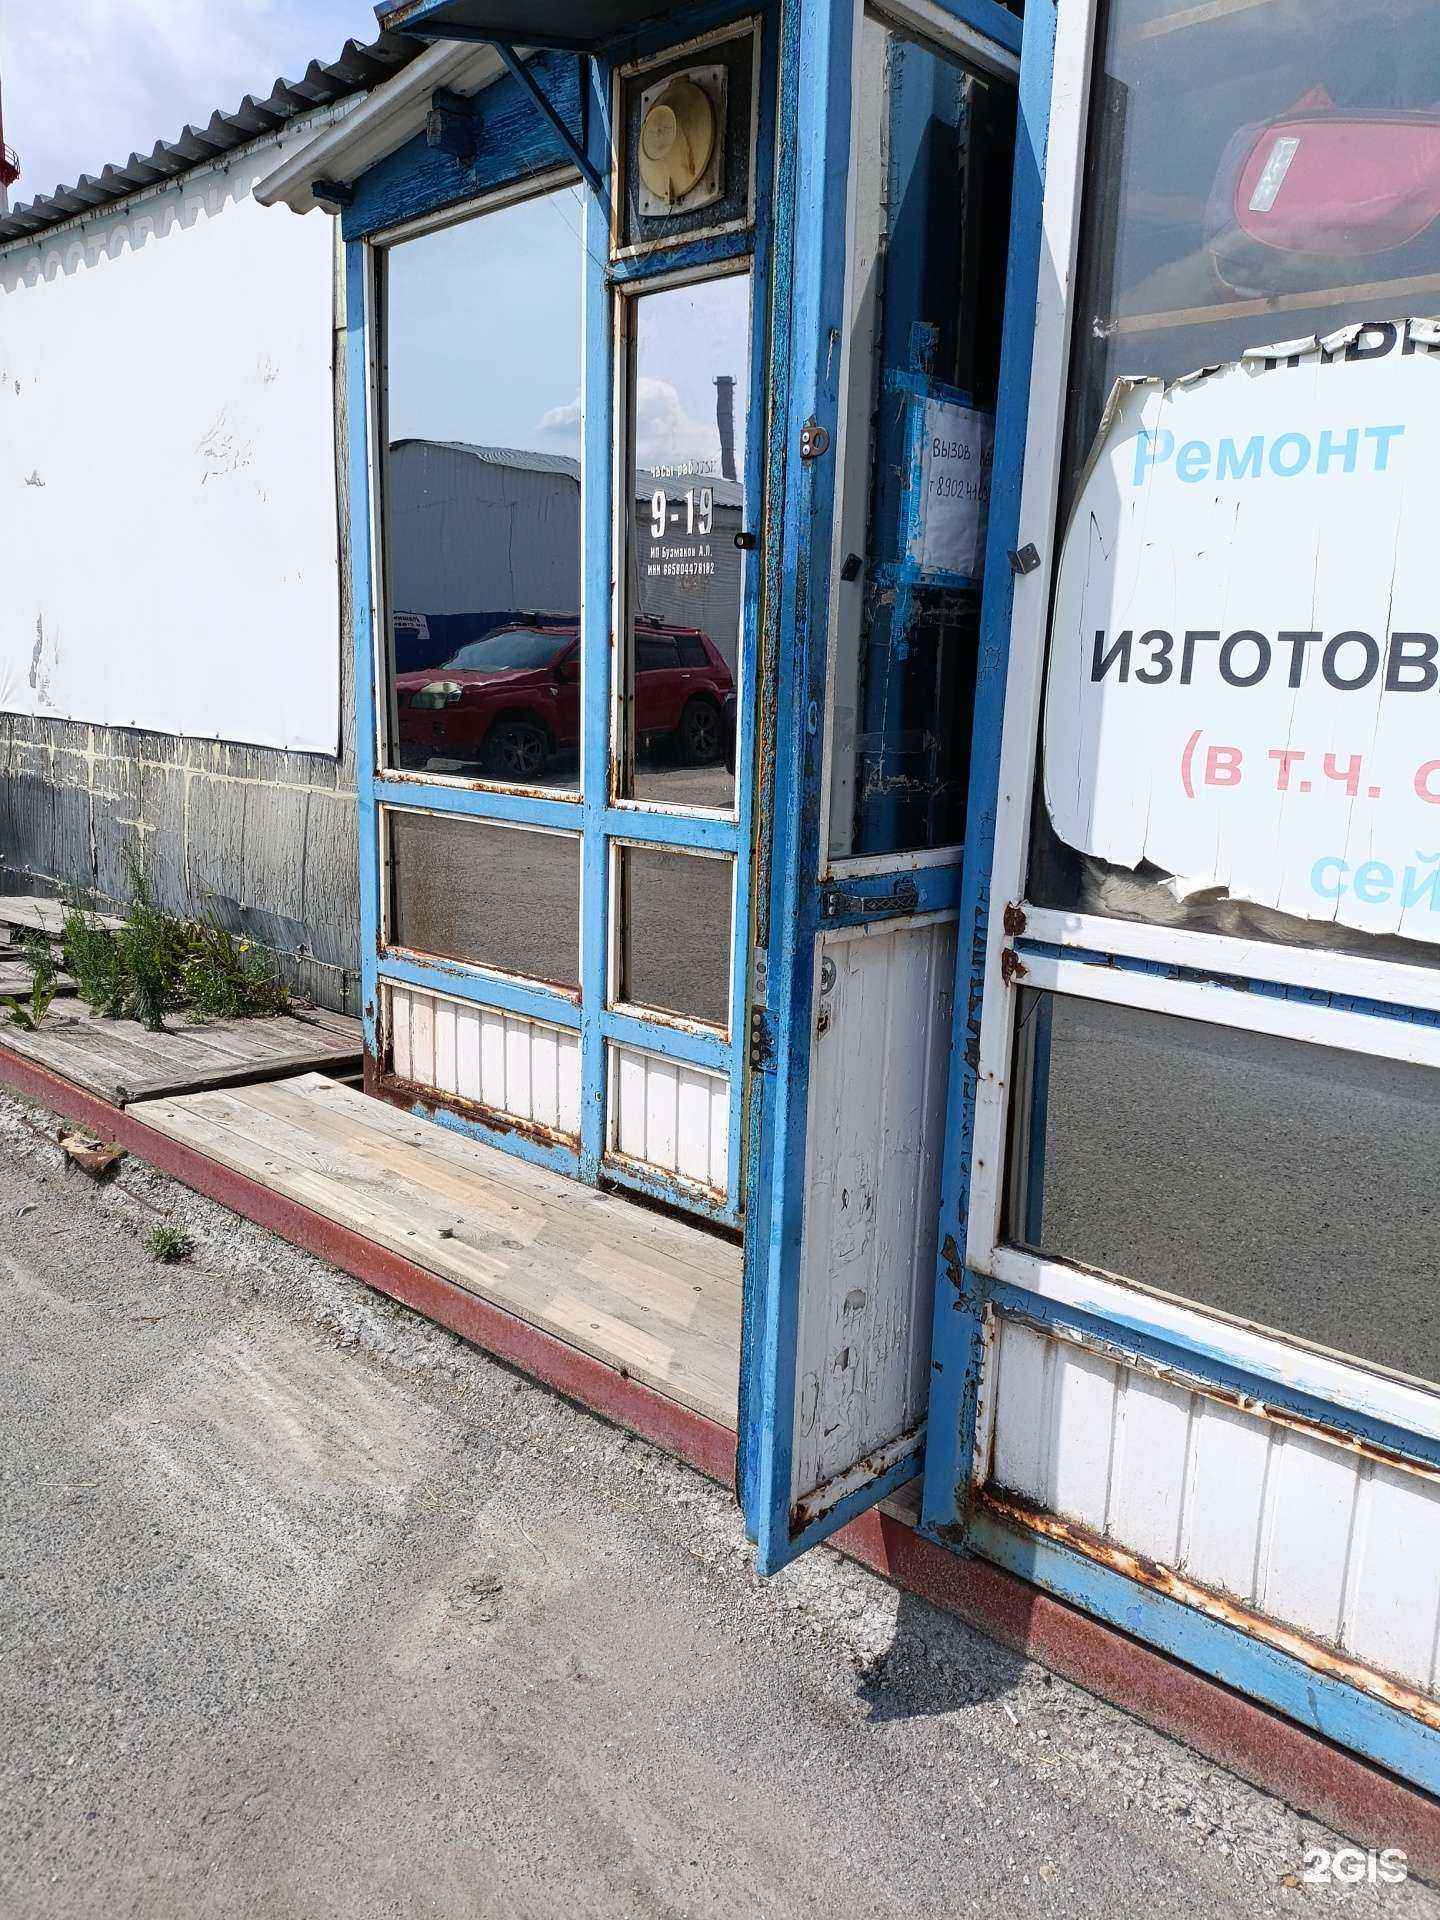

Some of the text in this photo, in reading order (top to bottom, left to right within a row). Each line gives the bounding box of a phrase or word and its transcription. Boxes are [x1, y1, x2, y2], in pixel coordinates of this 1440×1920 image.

[1131, 424, 1406, 487] Ремонт
[647, 564, 661, 576] ИНН
[1090, 629, 1440, 693] ИЗГОТОВ
